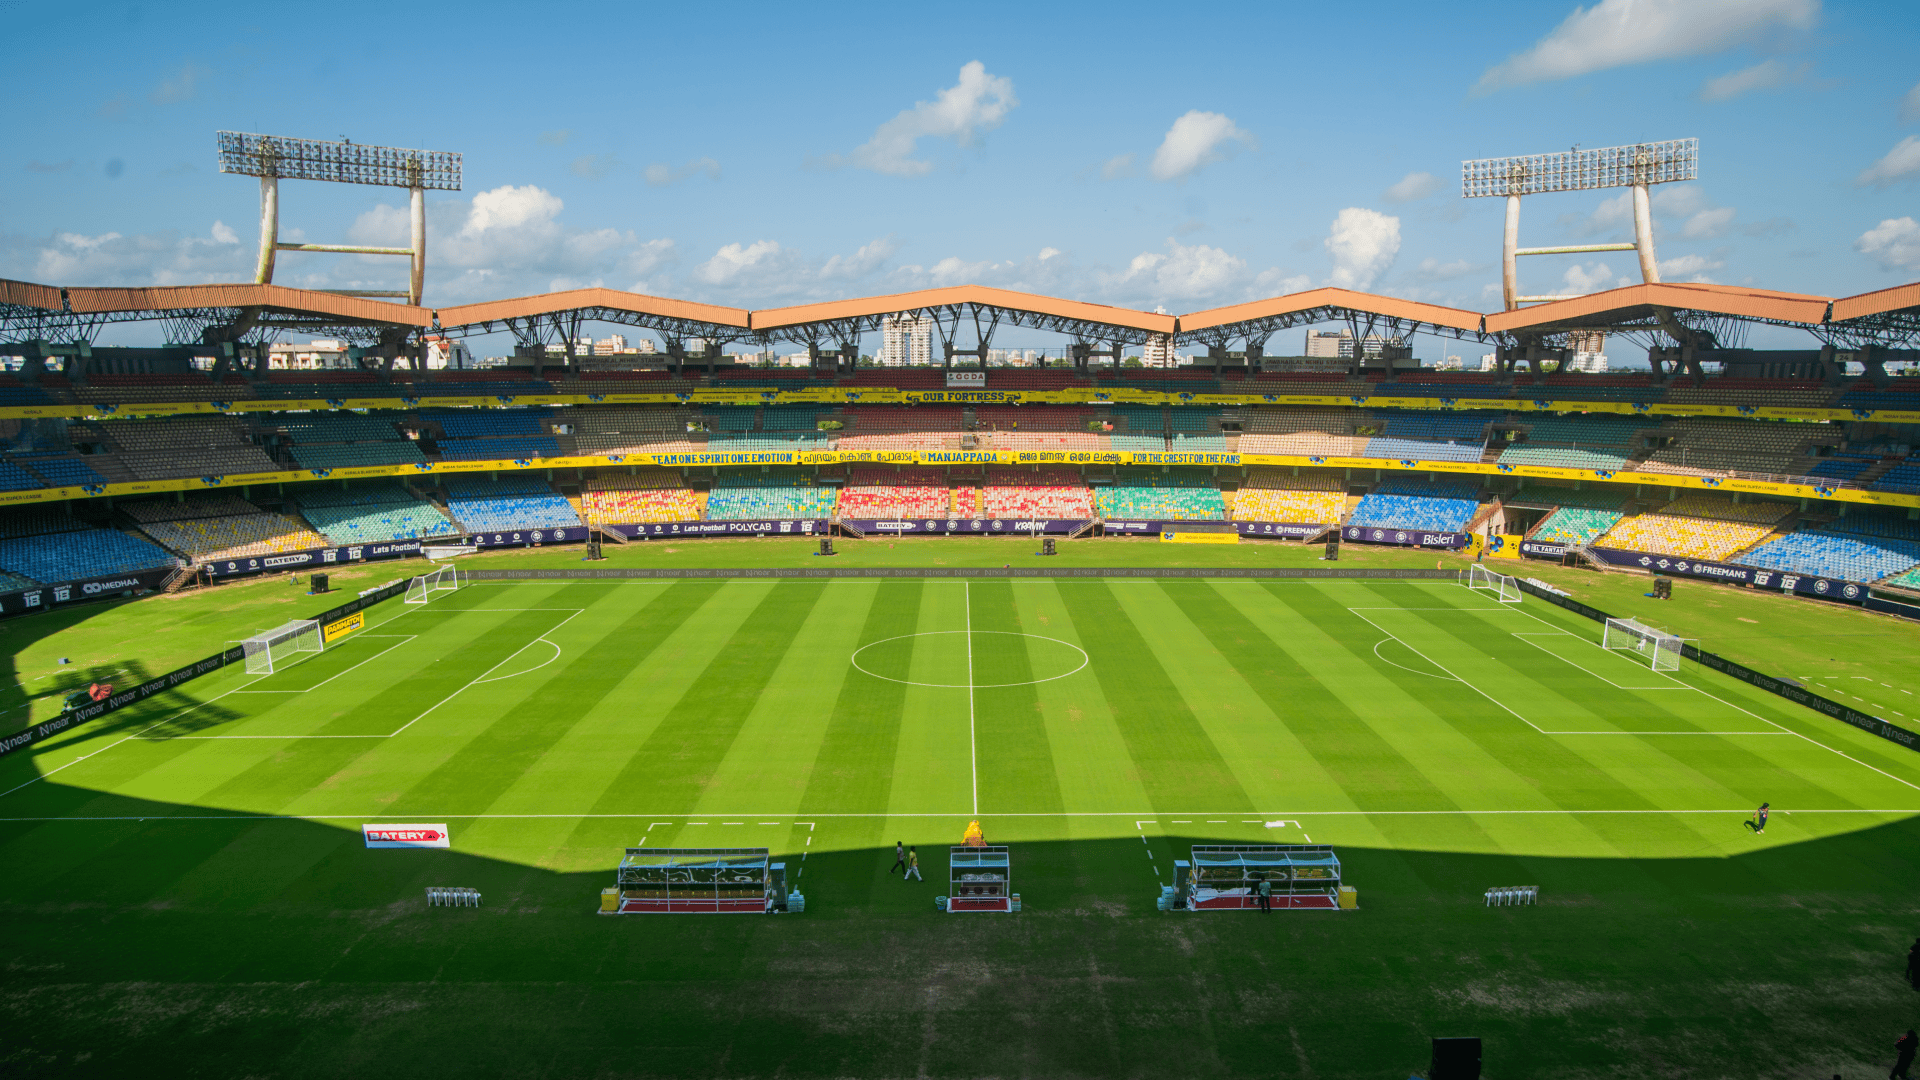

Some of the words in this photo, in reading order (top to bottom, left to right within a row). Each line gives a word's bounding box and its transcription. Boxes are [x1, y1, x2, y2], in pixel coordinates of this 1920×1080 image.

[923, 392, 945, 402] OUR
[948, 392, 1005, 402] FORTRESS
[651, 454, 676, 464] TEAM
[679, 454, 698, 463] ONE
[699, 454, 730, 463] SPIRIT
[731, 453, 750, 463] ONE
[752, 453, 793, 463] EMOTION
[928, 452, 998, 462] MANJAPPADA
[1133, 454, 1147, 463] FOR
[1148, 454, 1162, 463] THE
[1164, 454, 1188, 463] CREST
[1189, 454, 1203, 463] FOR
[1205, 454, 1219, 463] THE
[1221, 454, 1240, 463] FANS
[730, 522, 772, 531] POLYCAB
[1284, 526, 1321, 535] FREEMANS
[1423, 533, 1454, 545] Bisleri
[391, 542, 420, 553] Football
[266, 555, 300, 565] BATERY
[322, 552, 337, 562] 18
[347, 549, 362, 560] 18
[1702, 565, 1746, 579] FREEMANS
[101, 578, 139, 590] MEDHAA
[1754, 573, 1769, 585] 18
[1781, 577, 1796, 589] 18
[23, 594, 40, 607] 18
[53, 589, 70, 602] 18
[328, 614, 361, 636] PARIMATCH
[369, 831, 426, 842] BATERY
